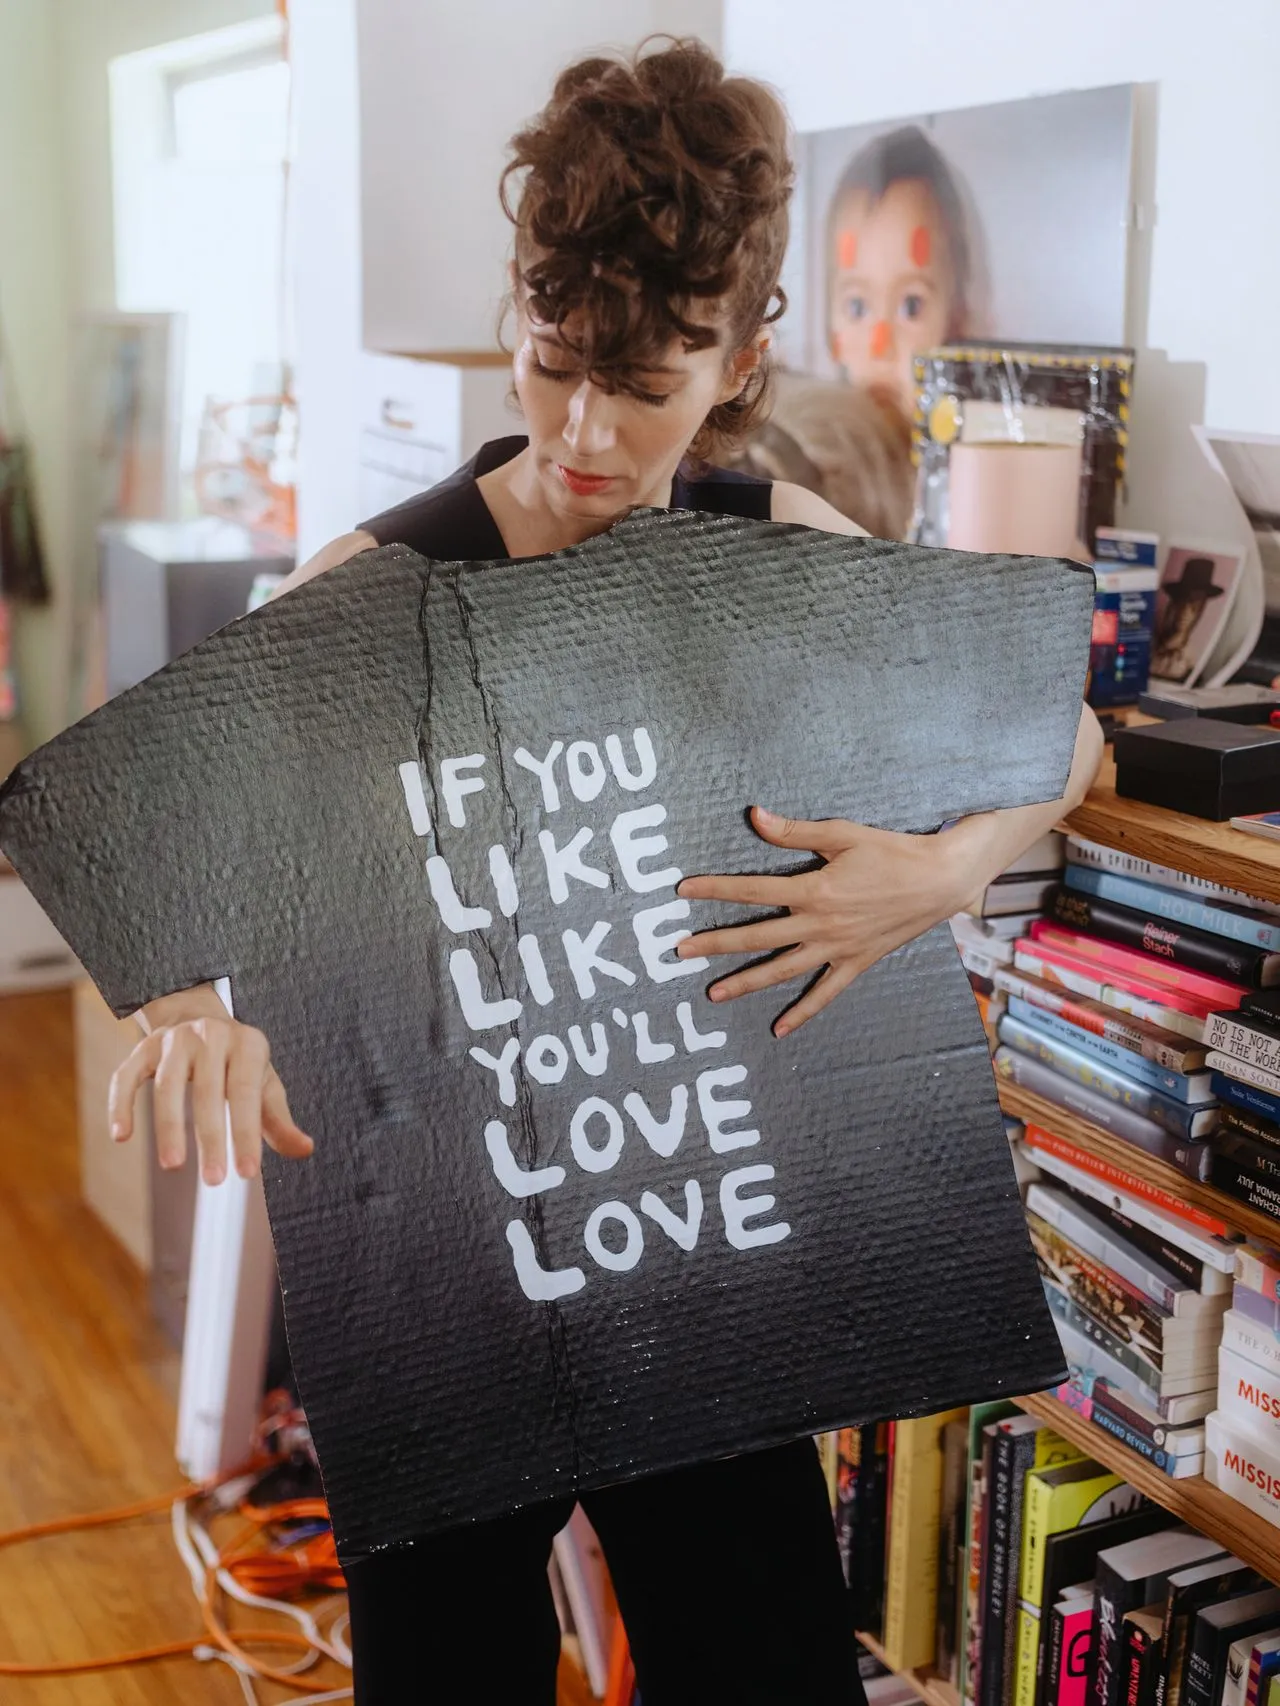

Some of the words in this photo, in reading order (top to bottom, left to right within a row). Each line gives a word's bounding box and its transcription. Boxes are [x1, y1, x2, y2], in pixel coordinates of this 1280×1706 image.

[400, 754, 486, 836] IF
[514, 727, 657, 812] YOU
[426, 804, 683, 933] LIKE
[1143, 921, 1180, 945] Reiner
[1159, 897, 1195, 918] HOT
[1202, 910, 1242, 936] MILK
[450, 899, 710, 1030] LIKE
[1142, 936, 1175, 958] Stach
[469, 1002, 727, 1106] YOU'LL
[1210, 1032, 1225, 1048] ON
[1229, 1040, 1252, 1059] THE
[1212, 1018, 1227, 1035] NO
[1231, 1026, 1245, 1041] IS
[1248, 1034, 1272, 1052] NOT
[1212, 1058, 1247, 1077] SUSAN
[484, 1064, 760, 1198] LOVE
[1237, 1174, 1254, 1190] JULY
[506, 1164, 791, 1300] LOVE
[997, 1438, 1009, 1467] THE
[1094, 1411, 1126, 1439] HARVARD
[1126, 1432, 1153, 1457] REVIEW
[996, 1471, 1008, 1517] BOOK
[995, 1518, 1007, 1540] OF
[991, 1542, 1005, 1618] SHRIGLEY
